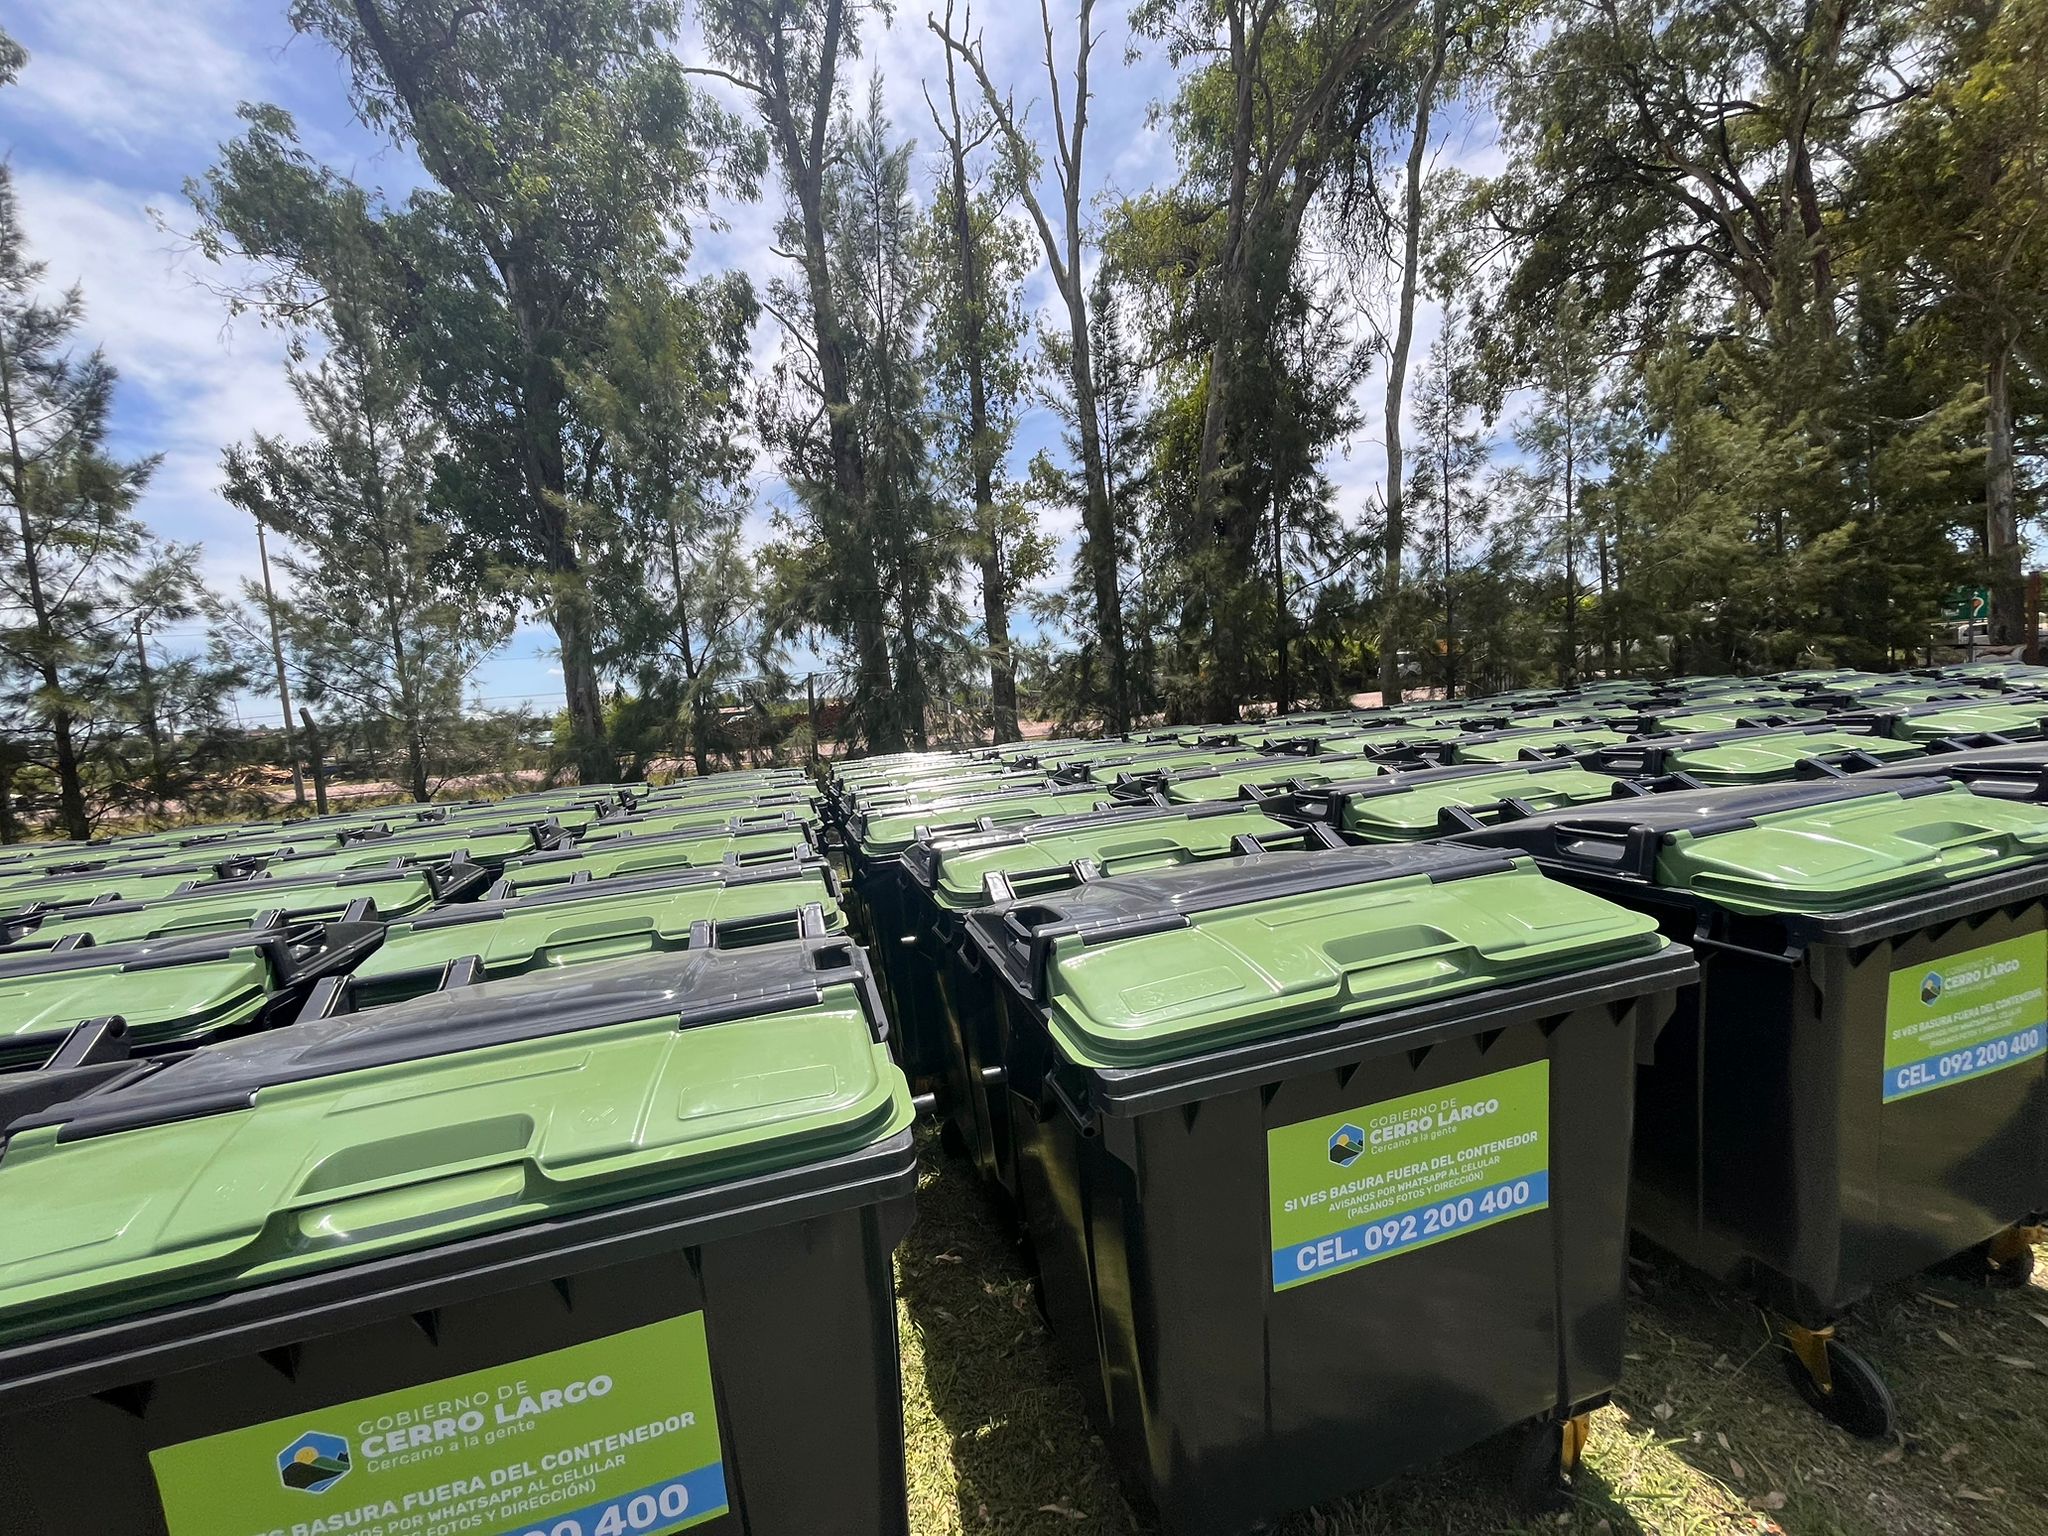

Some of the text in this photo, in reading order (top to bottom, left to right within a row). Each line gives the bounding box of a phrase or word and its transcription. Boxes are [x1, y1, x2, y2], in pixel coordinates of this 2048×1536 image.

[1944, 970, 1981, 990] CERRO
[1984, 959, 2019, 979] LARGO
[1897, 1063, 1936, 1089] CEL.
[1939, 1050, 1973, 1077] 092
[1976, 1040, 2008, 1067] 200
[2010, 1029, 2039, 1054] 400
[1370, 1098, 1457, 1128] GOBIERNO DE
[1370, 1099, 1498, 1144] CERRO LARGO
[1371, 1138, 1410, 1155] Cercano
[1420, 1133, 1428, 1142] la
[1431, 1125, 1457, 1140] gente
[1284, 1131, 1538, 1212] SI VES BASURA FUERA DEL CONTENEDOR
[1329, 1155, 1500, 1212] AVISANOS POR WHATSAPP AL CELULAR
[1296, 1181, 1529, 1272] CEL. 092 200 400
[1348, 1196, 1394, 1219] (PASANOS
[1396, 1187, 1425, 1204] FOTOS
[1427, 1185, 1433, 1194] Y
[358, 1380, 528, 1435] GOBIERNO DE
[361, 1375, 613, 1458] CERRO LARGO
[291, 1411, 696, 1536] BASURA FUERA DEL CONTENEDOR
[367, 1420, 535, 1473] Cercano a la gente
[387, 1514, 423, 1533] POR
[428, 1486, 523, 1522] WHATSAPP
[528, 1480, 549, 1494] AL
[552, 1455, 626, 1486] CELULAR
[426, 1479, 596, 1536] FOTOS Y DIRECCIÓN)
[594, 1484, 689, 1536] 400
